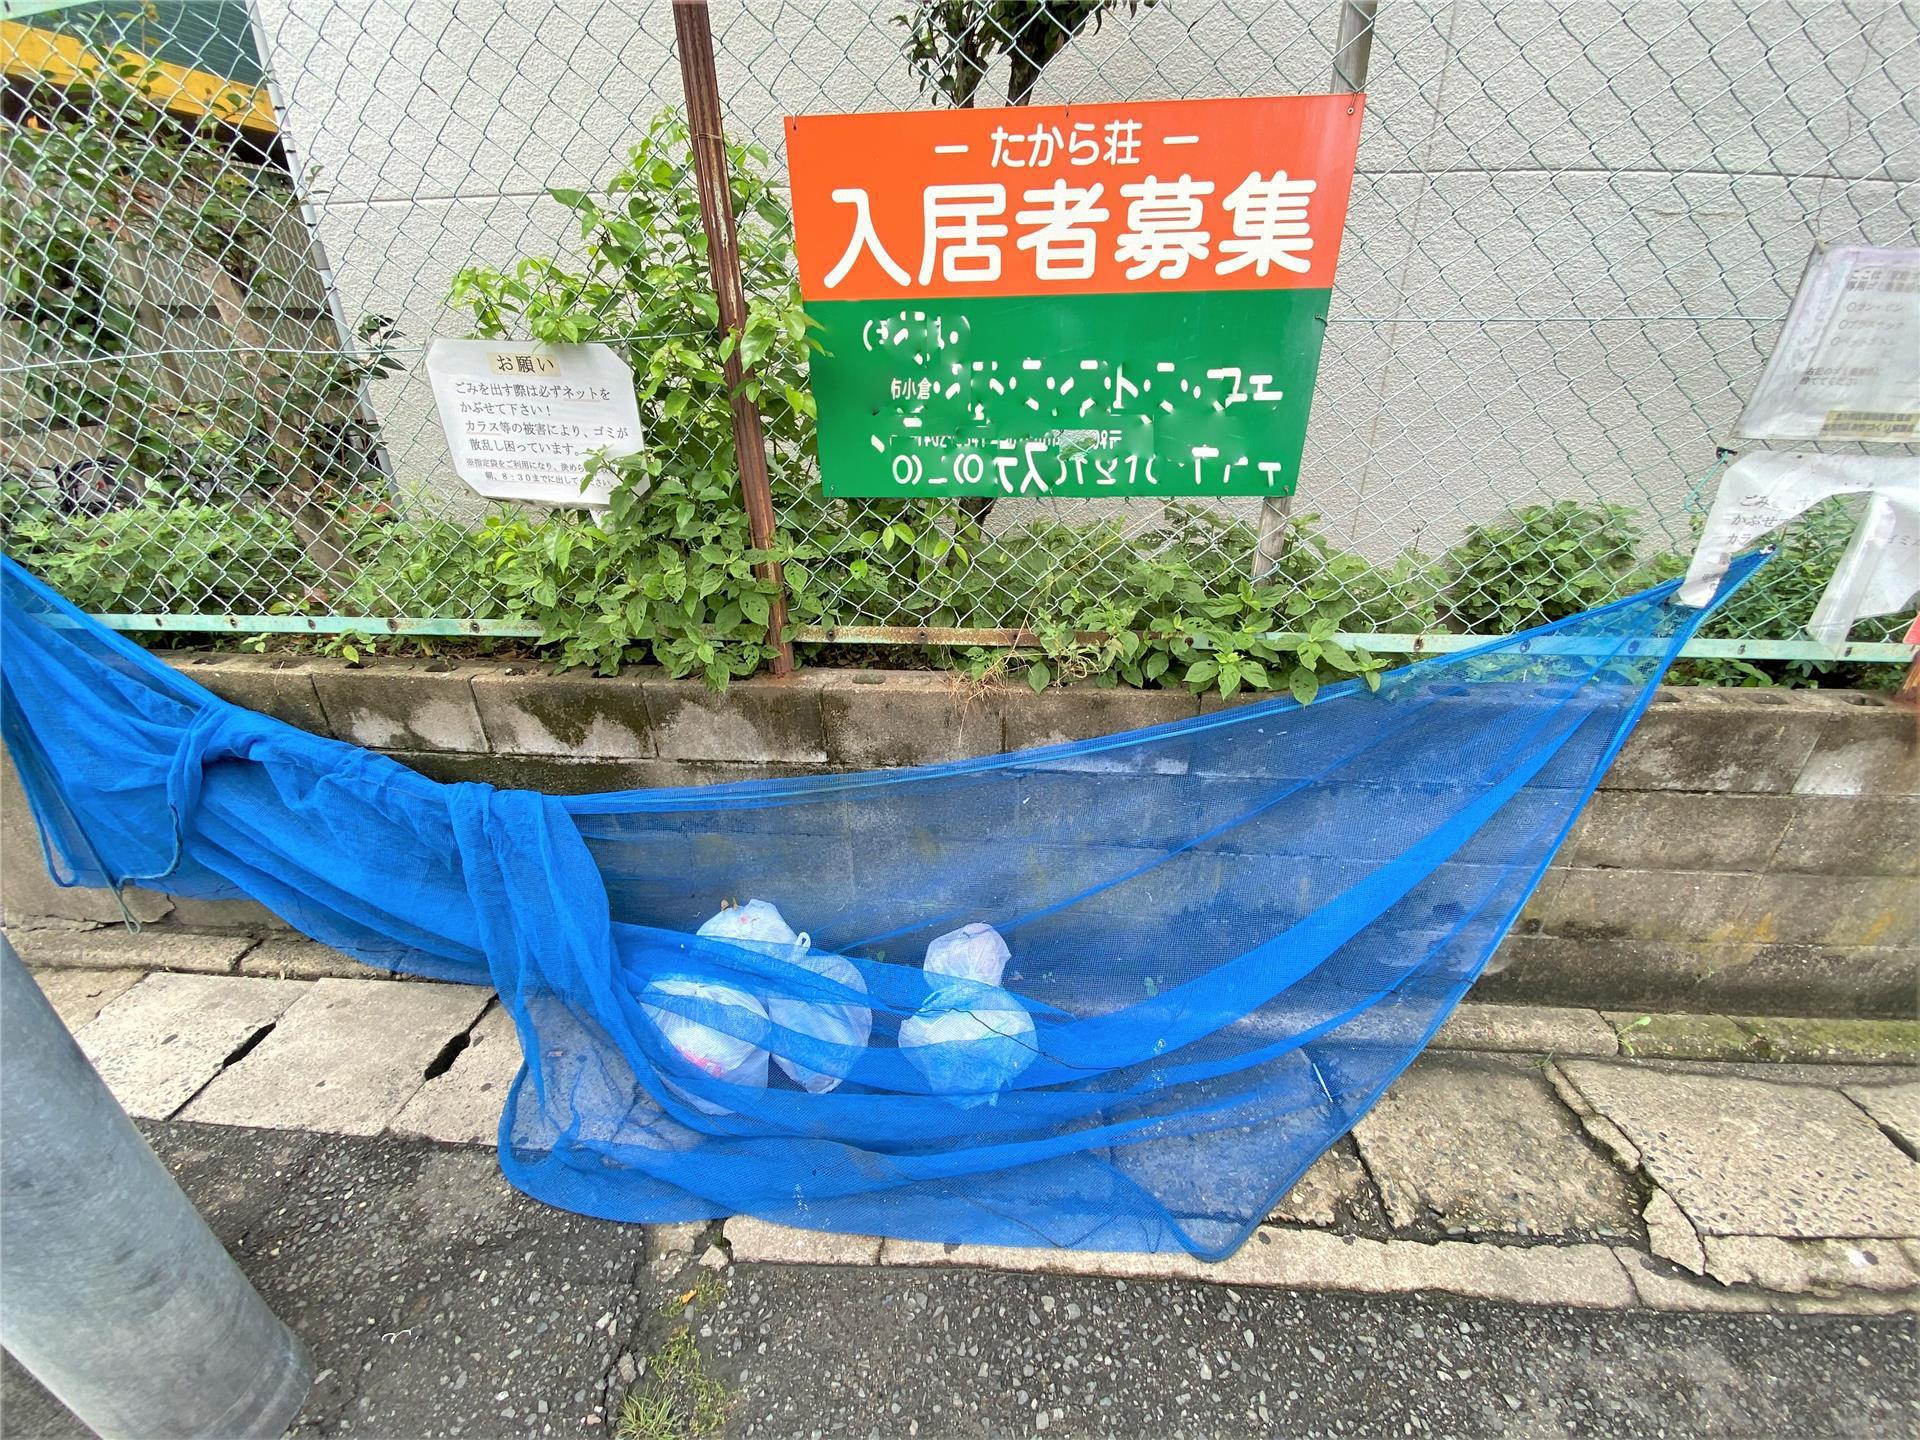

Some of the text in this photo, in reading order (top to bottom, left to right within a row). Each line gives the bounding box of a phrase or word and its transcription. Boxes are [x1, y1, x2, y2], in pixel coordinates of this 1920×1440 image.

[990, 119, 1143, 168] たから荘
[823, 169, 1318, 288] 入居者募集
[496, 354, 555, 374] お願い
[455, 382, 611, 401] ごみを出す際は必ずネットを
[465, 420, 628, 440] カラス等の被害により、ゴミが
[469, 438, 580, 458] 散乱し困っています。
